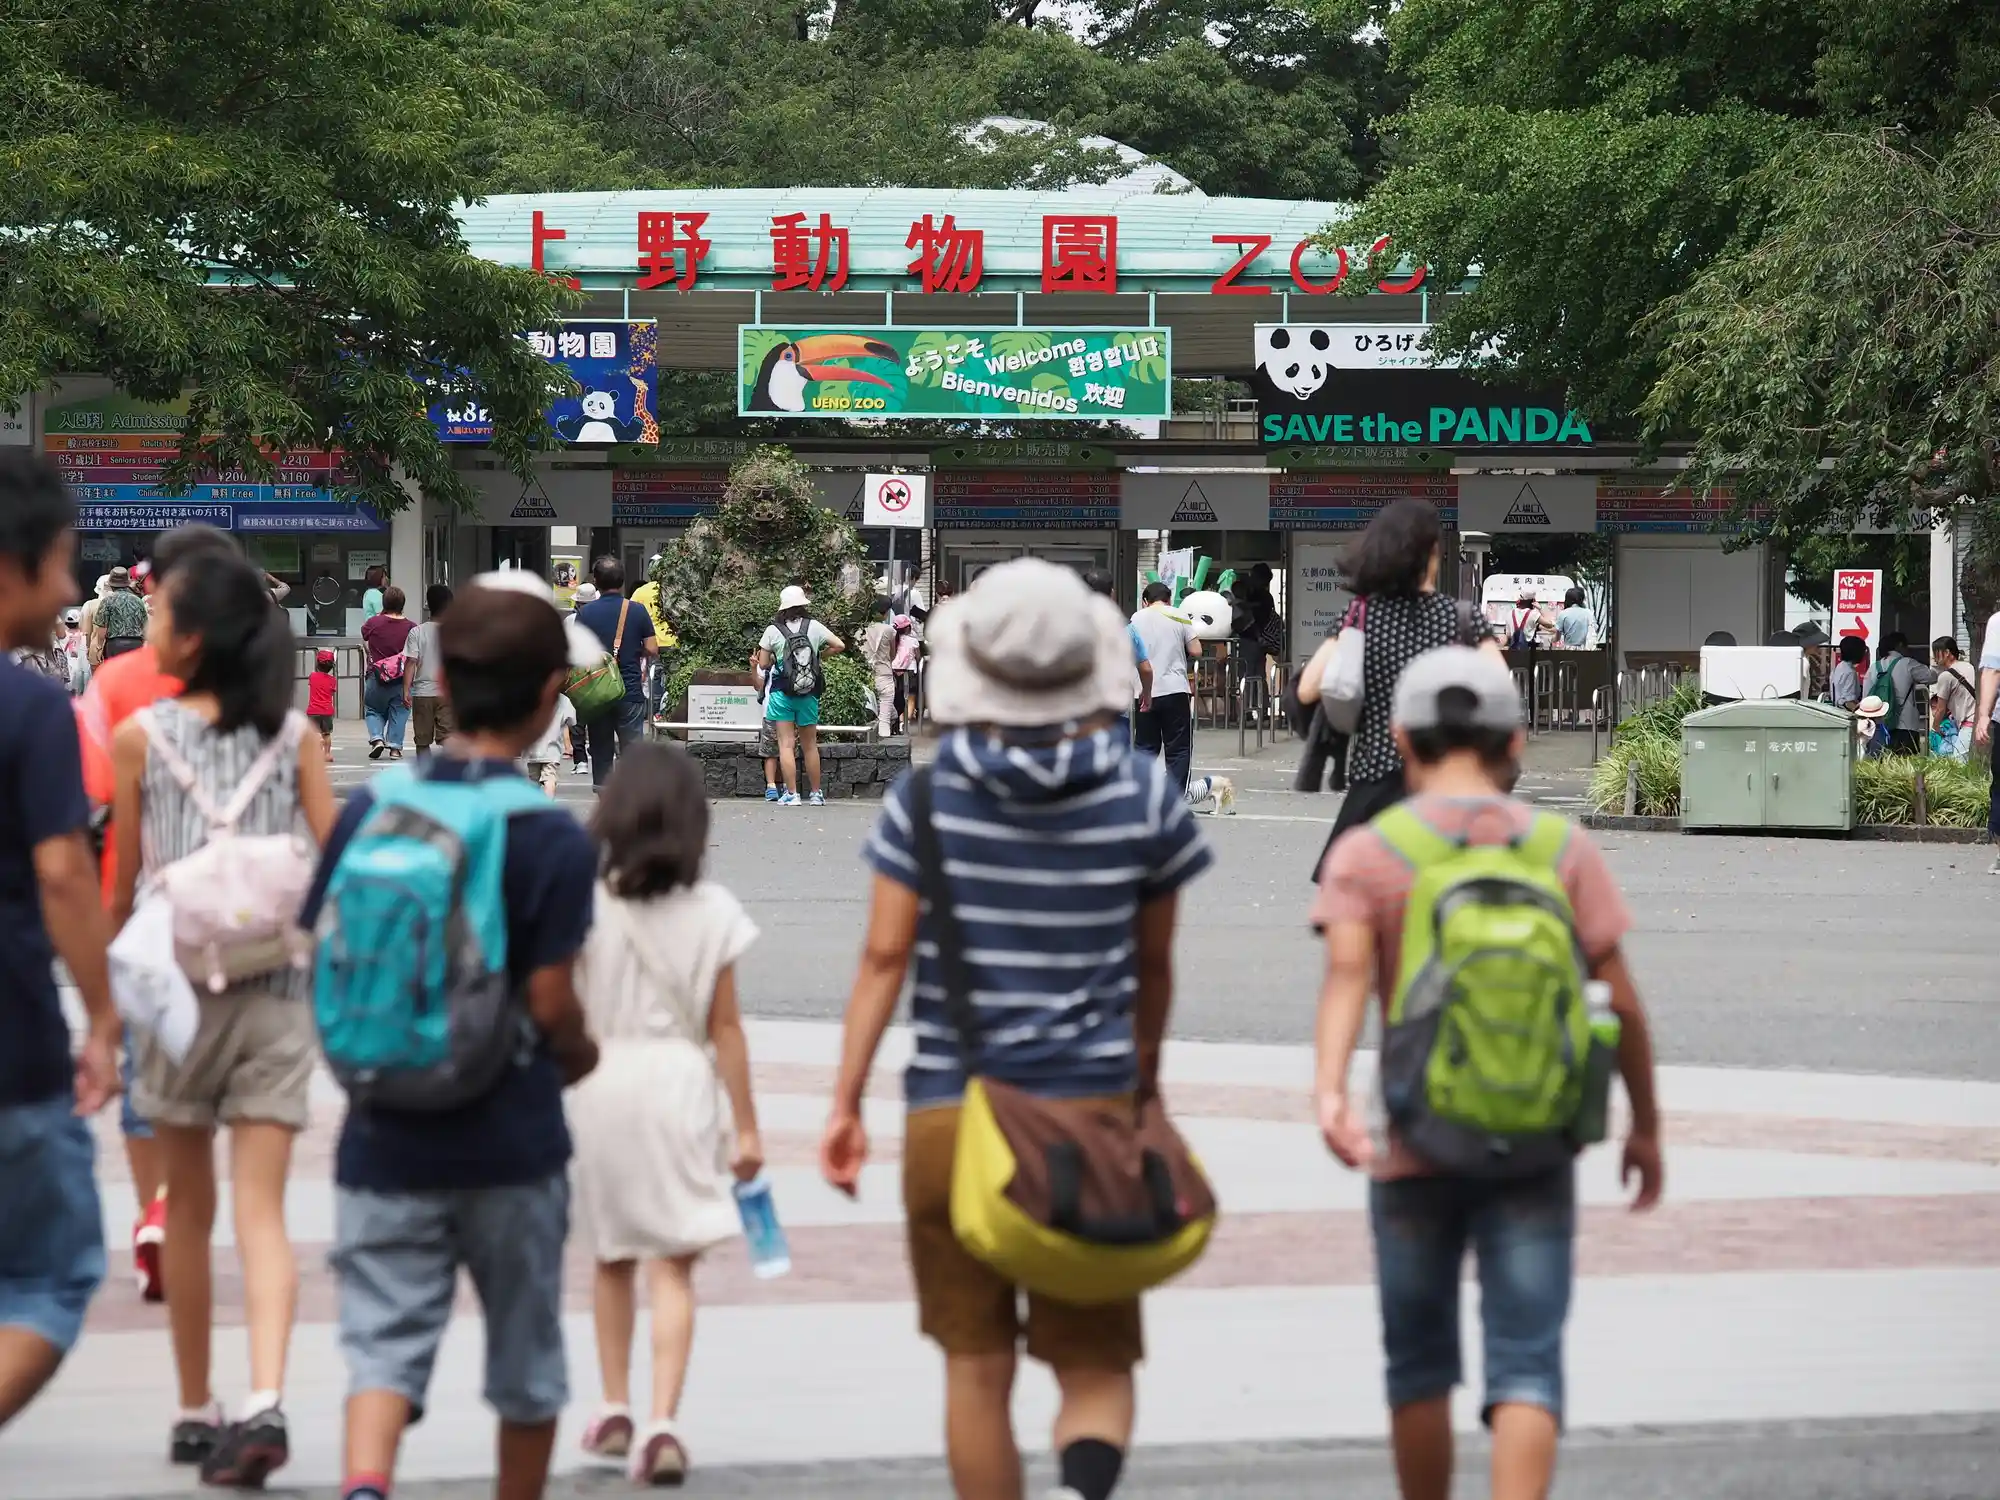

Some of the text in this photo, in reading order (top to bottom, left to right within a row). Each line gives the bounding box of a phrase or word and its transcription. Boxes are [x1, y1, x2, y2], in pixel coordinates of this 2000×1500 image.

[532, 210, 1118, 293] 上野動物園
[513, 331, 617, 358] 動物園
[905, 338, 985, 378] ようこそ
[984, 337, 1087, 377] Welcome
[1068, 336, 1160, 377] 환영합니다
[941, 371, 1079, 414] Bienvenidos
[1082, 382, 1127, 409] 欢迎
[812, 397, 886, 410] UENO ZOO
[58, 412, 104, 429] 入園料
[110, 411, 191, 429] Admission
[1263, 406, 1593, 443] SAVE the PANDA
[972, 443, 1072, 458] チケット販売機
[58, 455, 72, 465] 65
[110, 456, 136, 465] Seniors
[217, 471, 247, 482] ¥200
[280, 471, 310, 482] ¥160
[138, 488, 165, 497] Childre
[231, 488, 254, 498] Free
[295, 488, 317, 498] Free
[513, 508, 553, 518] ENTRANCE
[1174, 513, 1216, 522] ENTRANCE
[1506, 515, 1548, 524] ENTRANCE
[1839, 576, 1873, 588] ベビーカー
[1768, 741, 1818, 752] を大切に
